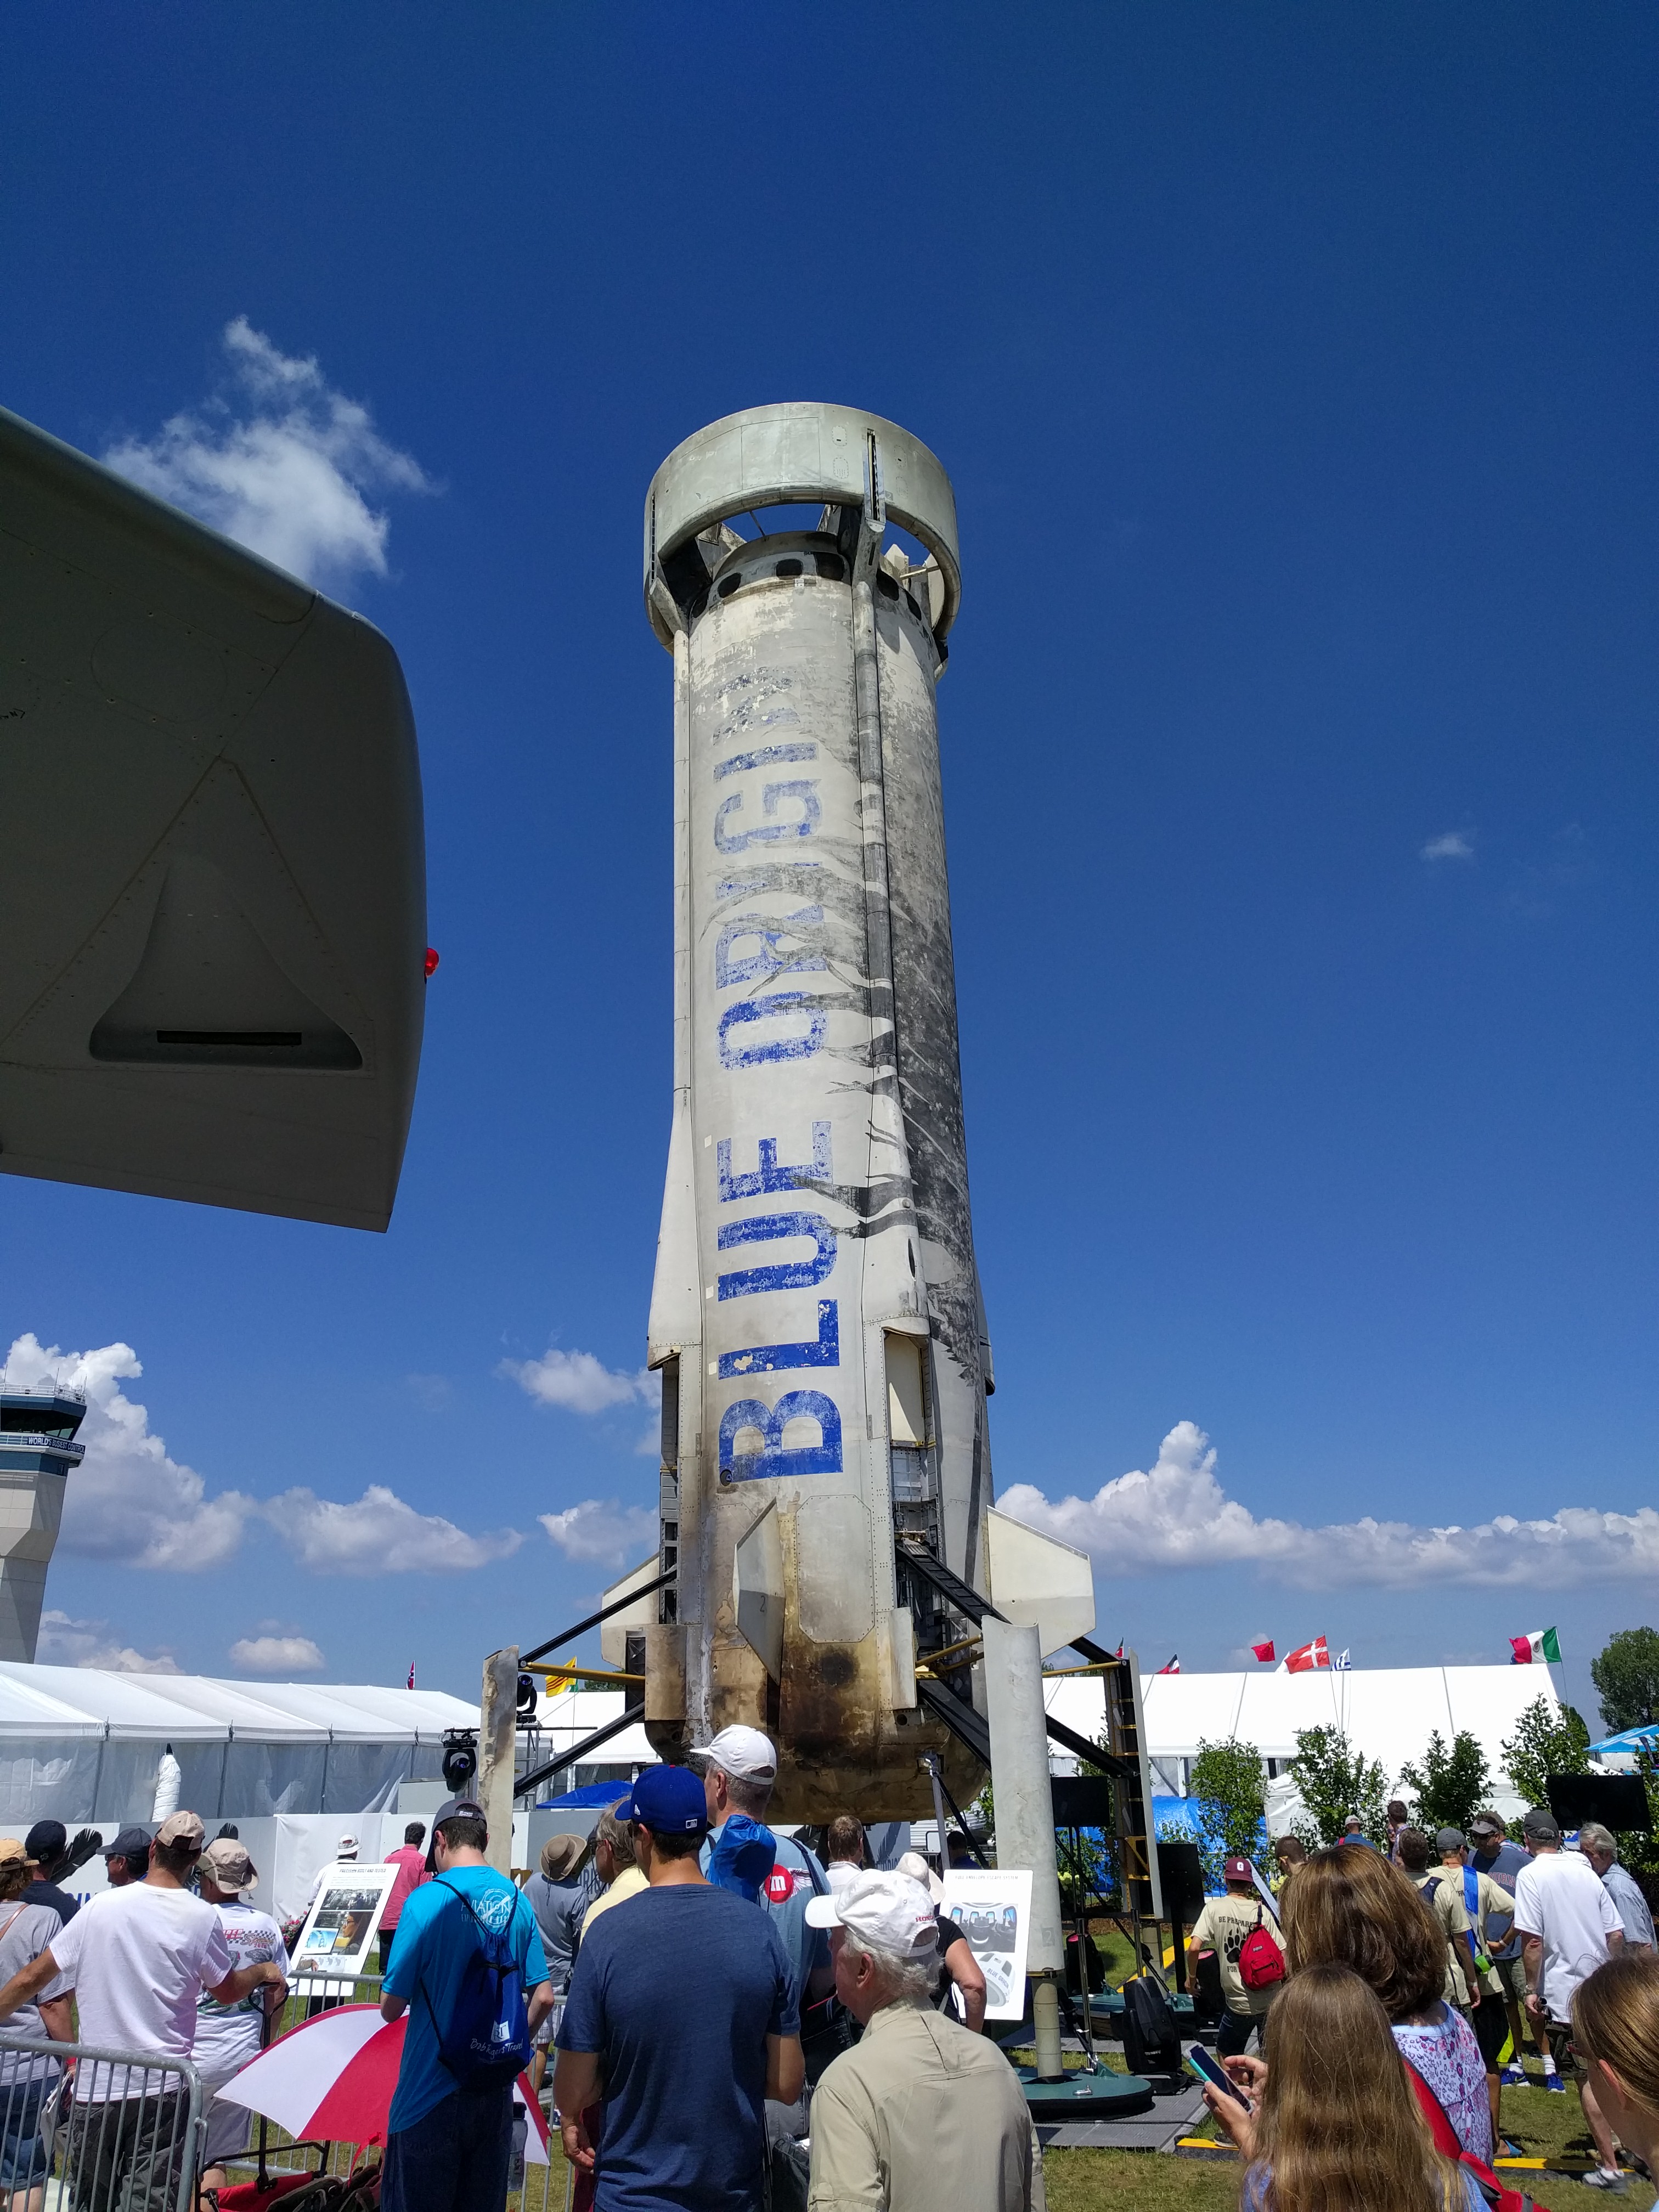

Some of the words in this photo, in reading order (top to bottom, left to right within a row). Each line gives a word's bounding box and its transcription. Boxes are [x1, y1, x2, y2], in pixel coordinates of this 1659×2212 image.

[716, 1121, 844, 1483] BLUE
[29, 1436, 52, 1446] WORLD'S
[52, 1440, 67, 1449] BUSIEST
[67, 1442, 84, 1453] CONTROL
[760, 1595, 766, 1612] 2
[1227, 1916, 1254, 1928] PREPARE
[987, 1968, 998, 1978] BLUE
[504, 2038, 523, 2052] Travel
